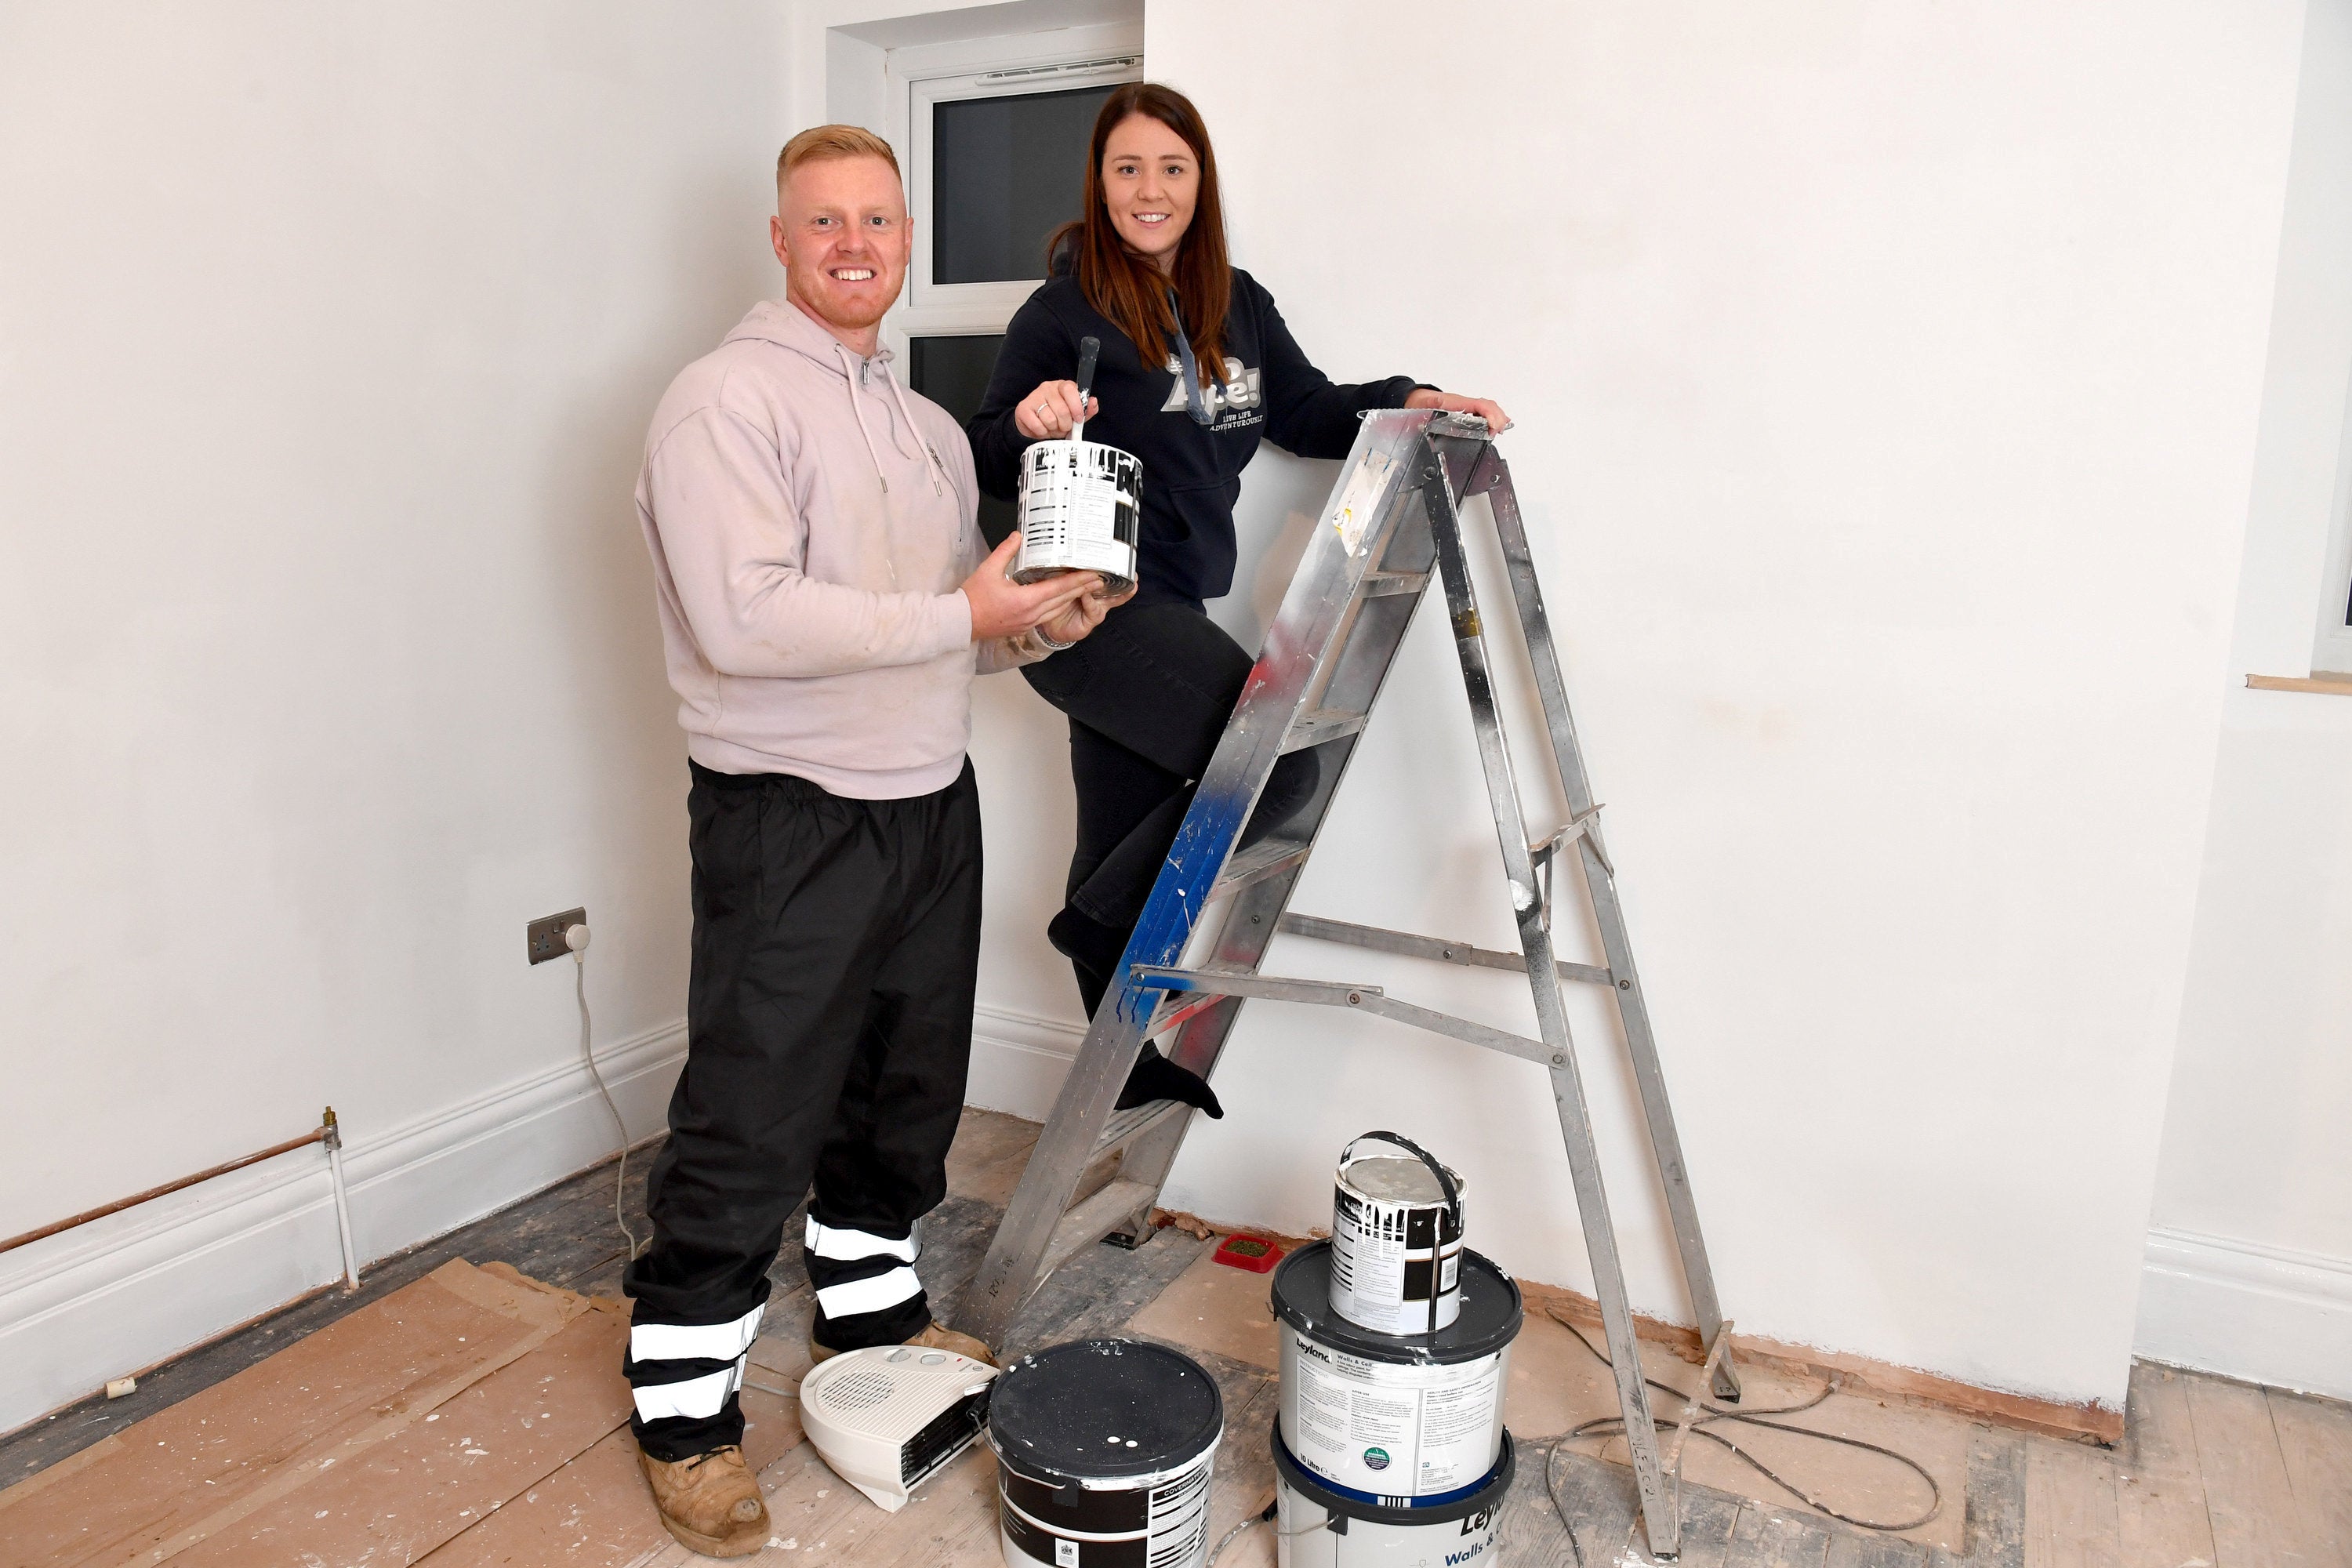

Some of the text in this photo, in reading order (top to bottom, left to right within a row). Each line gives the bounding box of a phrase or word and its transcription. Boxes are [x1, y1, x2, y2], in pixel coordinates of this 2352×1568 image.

[1238, 410, 1252, 419] LIFE
[1209, 415, 1264, 431] ADVENTUROUSLY
[1338, 1354, 1352, 1363] Walls
[1300, 1453, 1320, 1472] 10 Litre
[1445, 1532, 1494, 1566] Walls &
